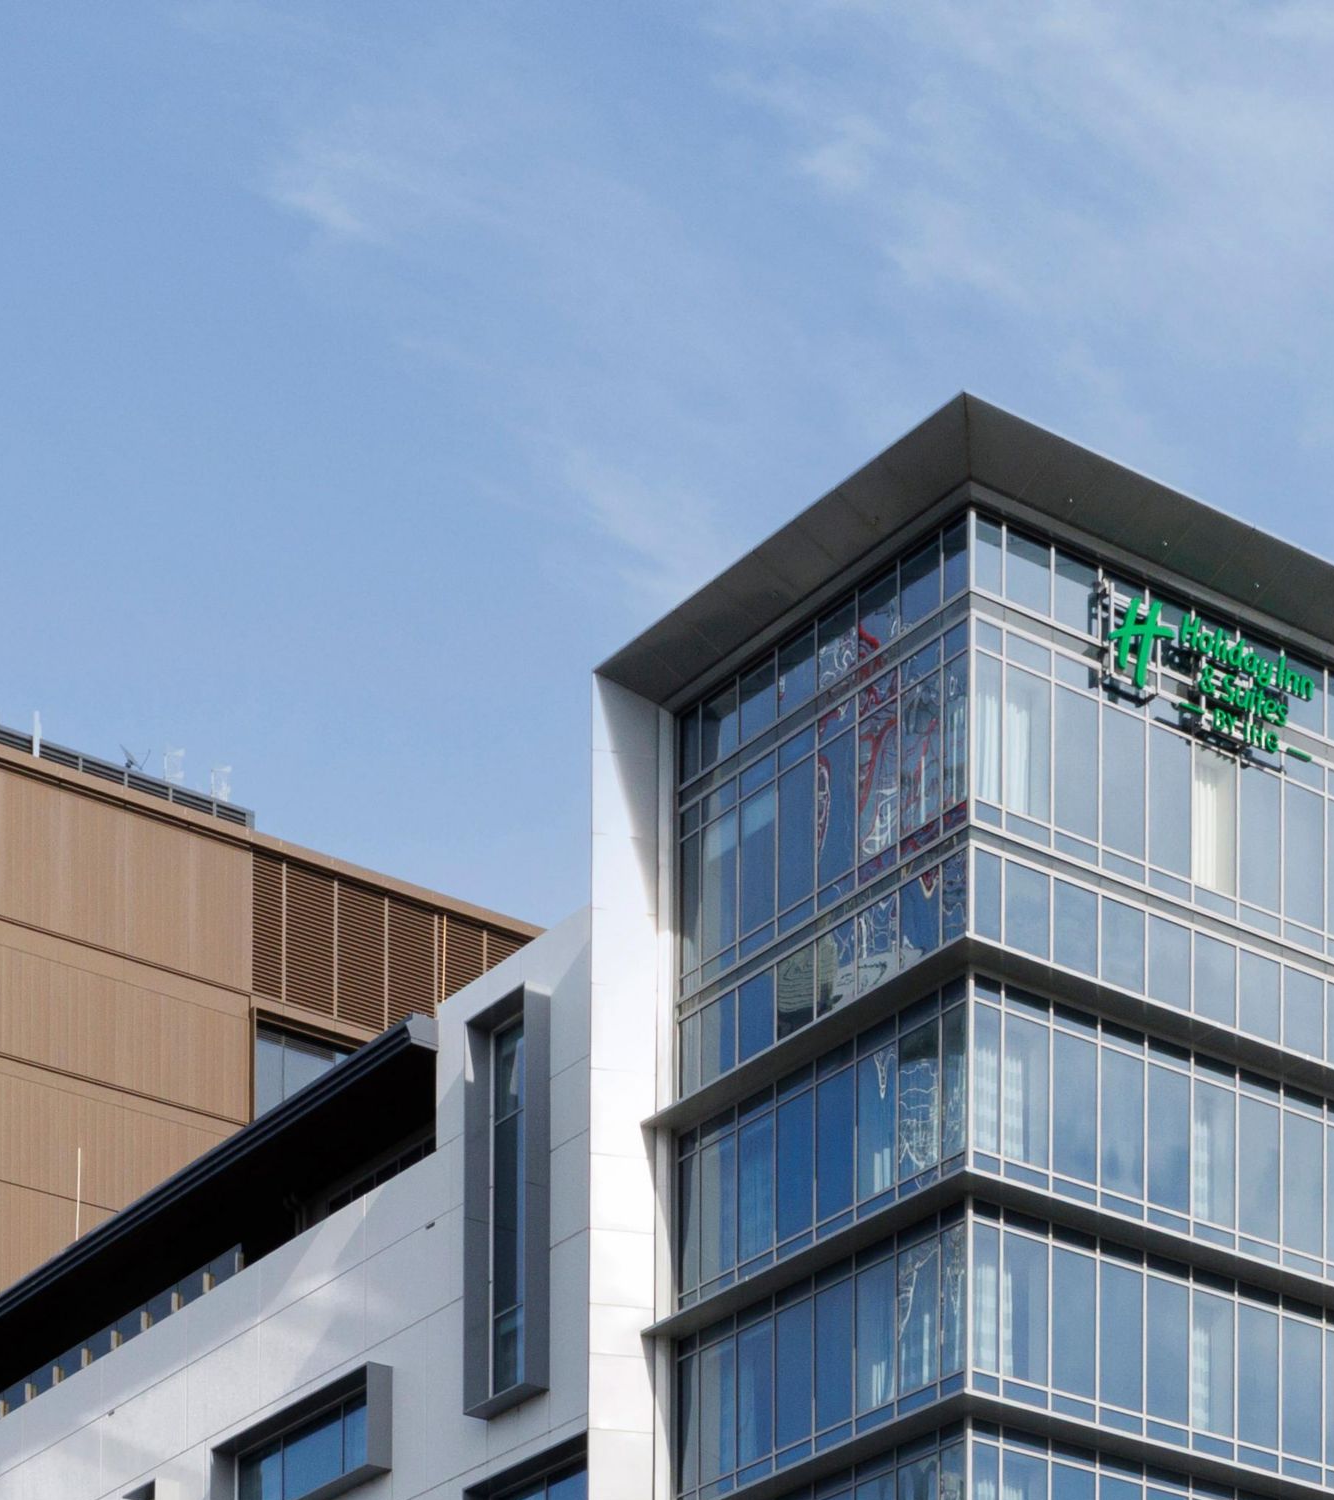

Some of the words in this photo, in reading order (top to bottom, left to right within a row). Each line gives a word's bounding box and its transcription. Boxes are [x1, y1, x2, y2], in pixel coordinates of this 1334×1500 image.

[1180, 613, 1274, 687] Holiday
[1276, 655, 1315, 701] Inn
[1198, 664, 1216, 693] &
[1219, 674, 1289, 727] Suites
[1212, 708, 1239, 735] BY
